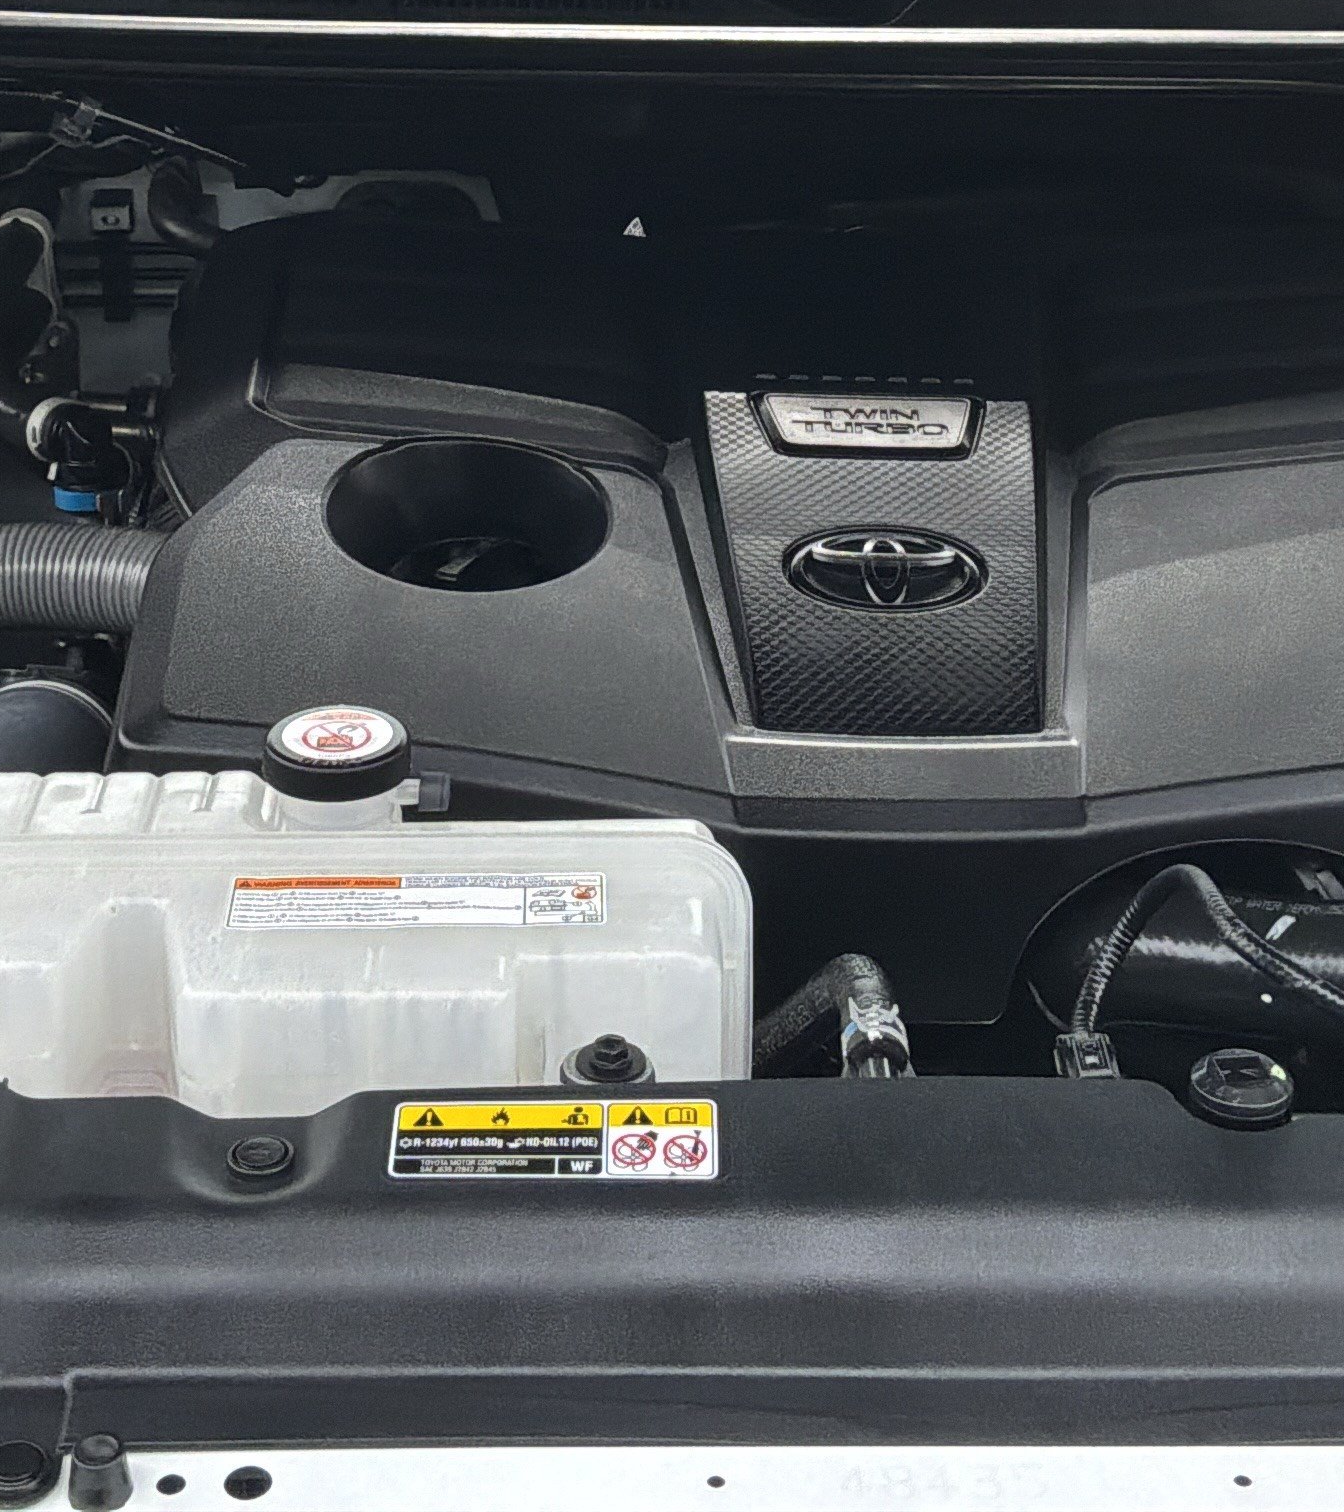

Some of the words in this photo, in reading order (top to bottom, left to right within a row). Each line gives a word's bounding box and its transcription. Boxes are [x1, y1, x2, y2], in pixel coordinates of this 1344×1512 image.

[810, 406, 920, 422] TWIN
[791, 419, 950, 436] TURBO
[571, 1136, 599, 1148] (POE)
[420, 1158, 449, 1166] TOYOTA
[570, 1160, 594, 1173] WF
